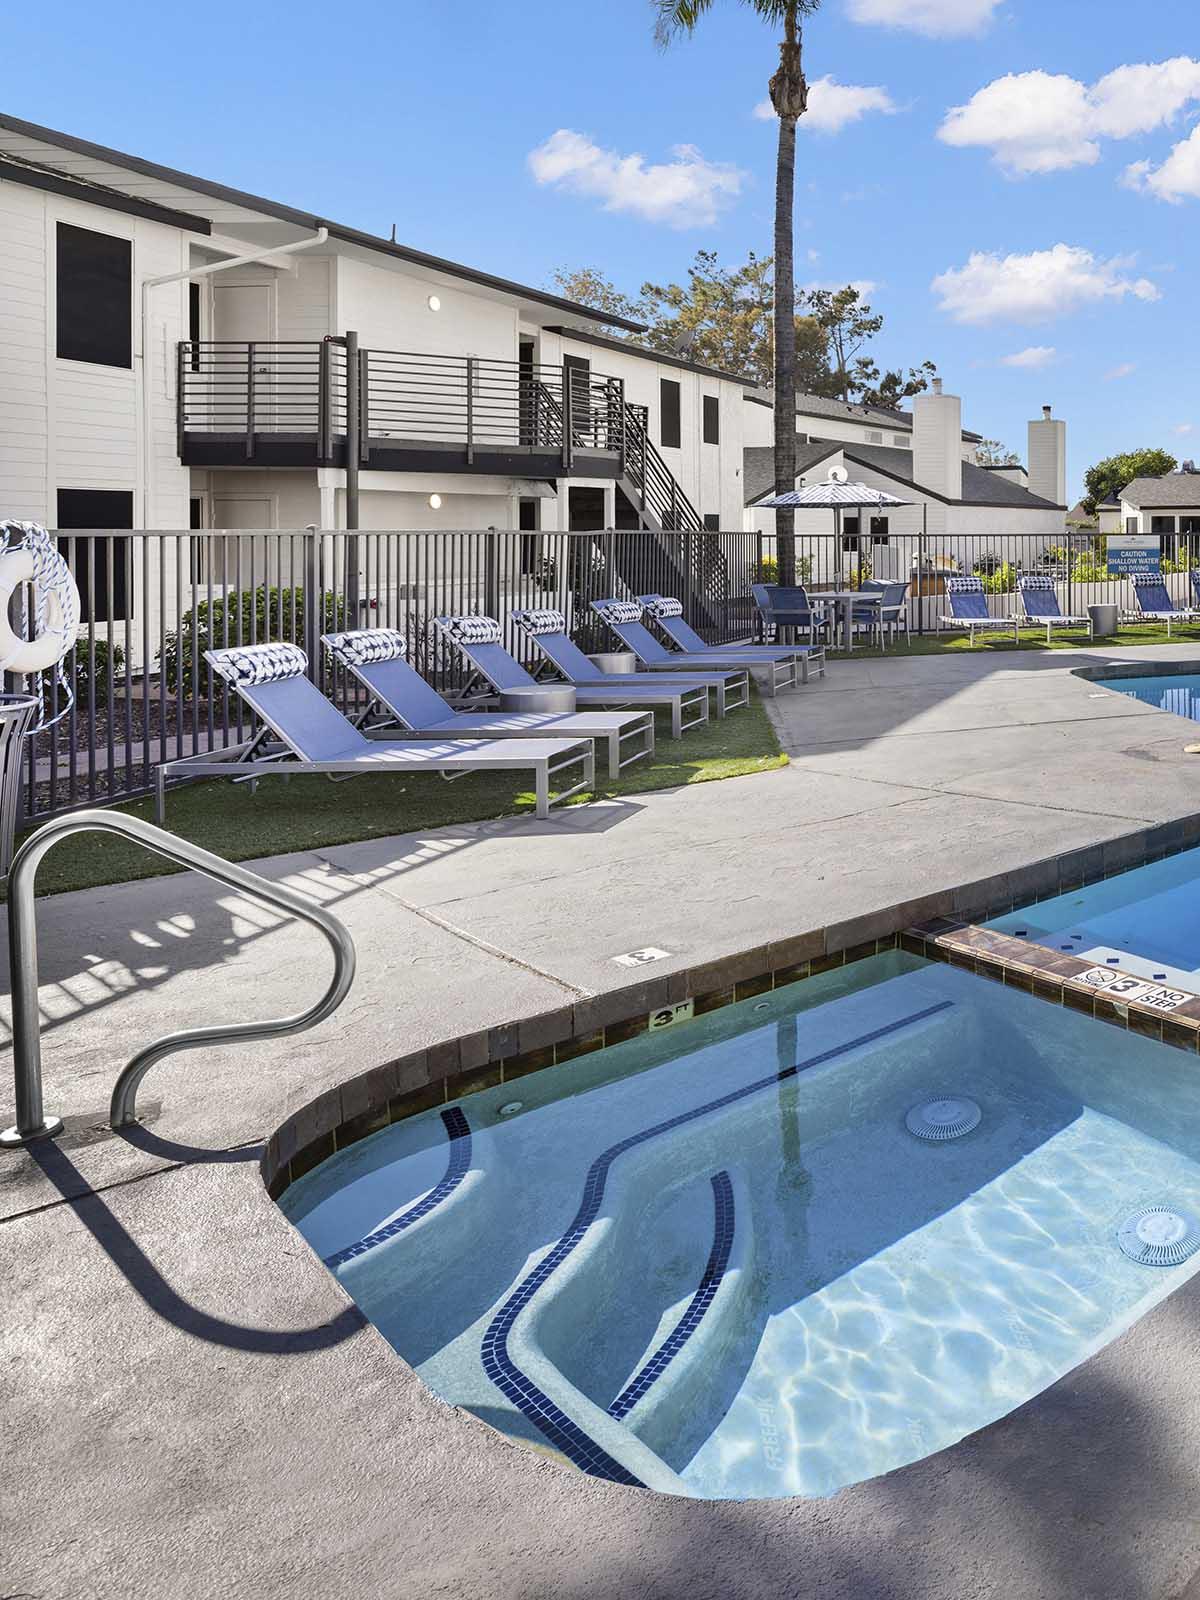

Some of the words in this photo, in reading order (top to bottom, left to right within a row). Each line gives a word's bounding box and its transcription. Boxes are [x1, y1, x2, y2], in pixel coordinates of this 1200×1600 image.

[1110, 980, 1140, 993] 3
[1156, 990, 1185, 1001] NO
[1141, 996, 1176, 1009] STEP
[653, 1010, 674, 1027] 3
[675, 1002, 690, 1013] FT
